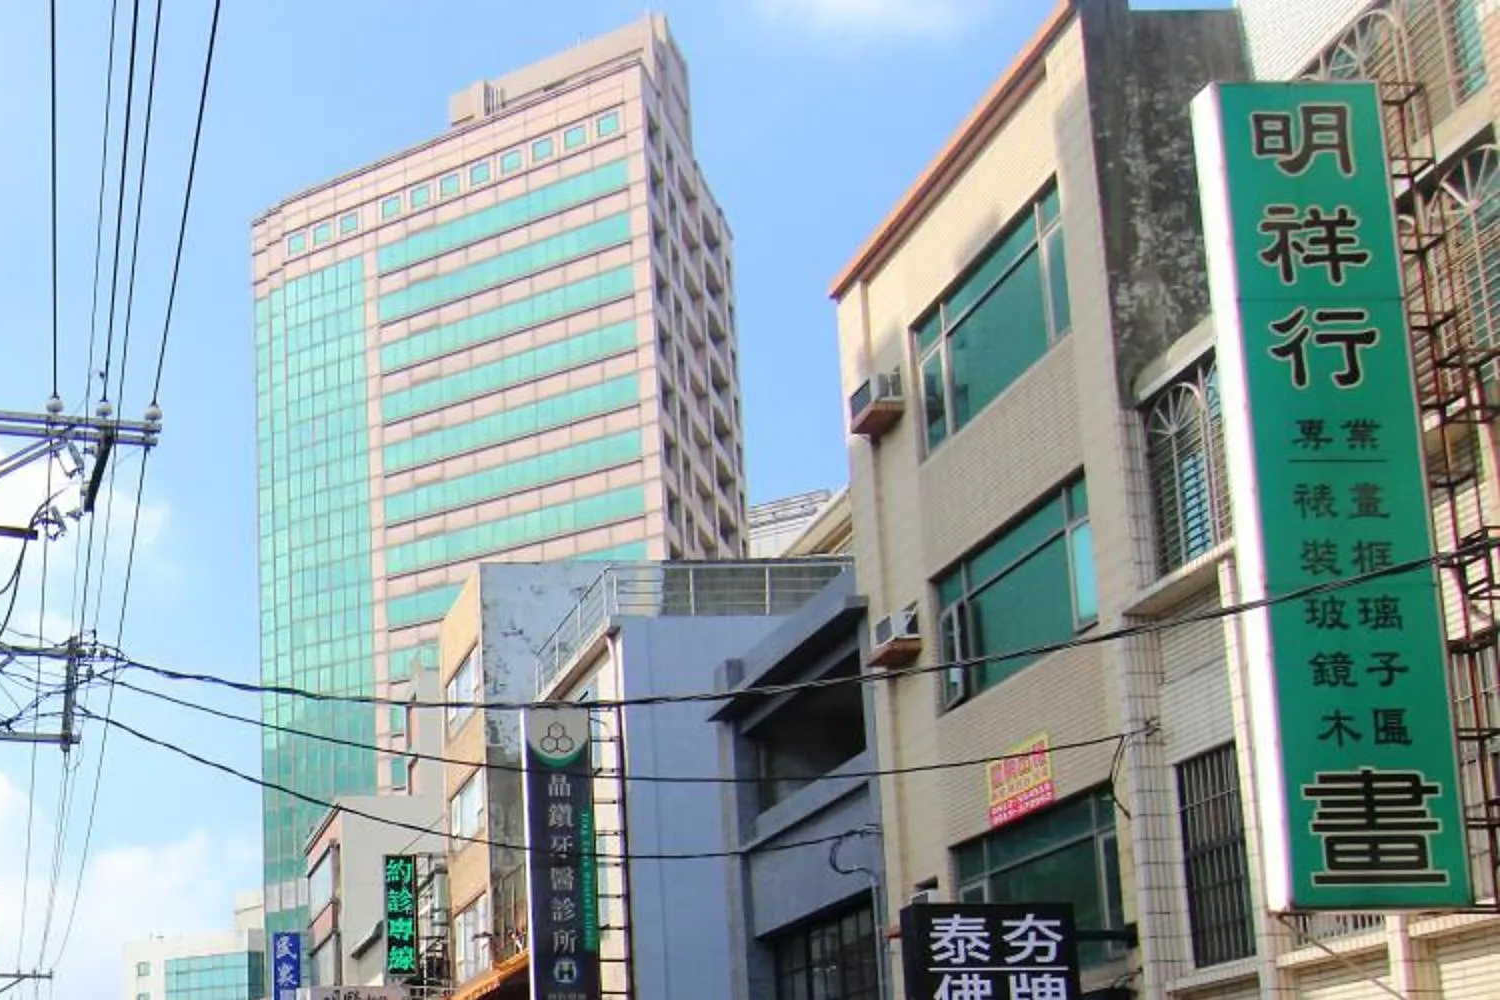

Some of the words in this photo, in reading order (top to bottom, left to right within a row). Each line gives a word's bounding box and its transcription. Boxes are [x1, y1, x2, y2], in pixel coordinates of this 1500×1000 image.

[1250, 104, 1378, 388] 明祥行
[1293, 418, 1382, 450] 專業
[1294, 482, 1390, 520] 裱畫
[1300, 539, 1393, 576] 裝框
[1304, 595, 1404, 631] 玻璃
[1308, 651, 1410, 688] 鏡子
[1302, 765, 1449, 886] 畫
[928, 912, 1064, 965] 泰夯
